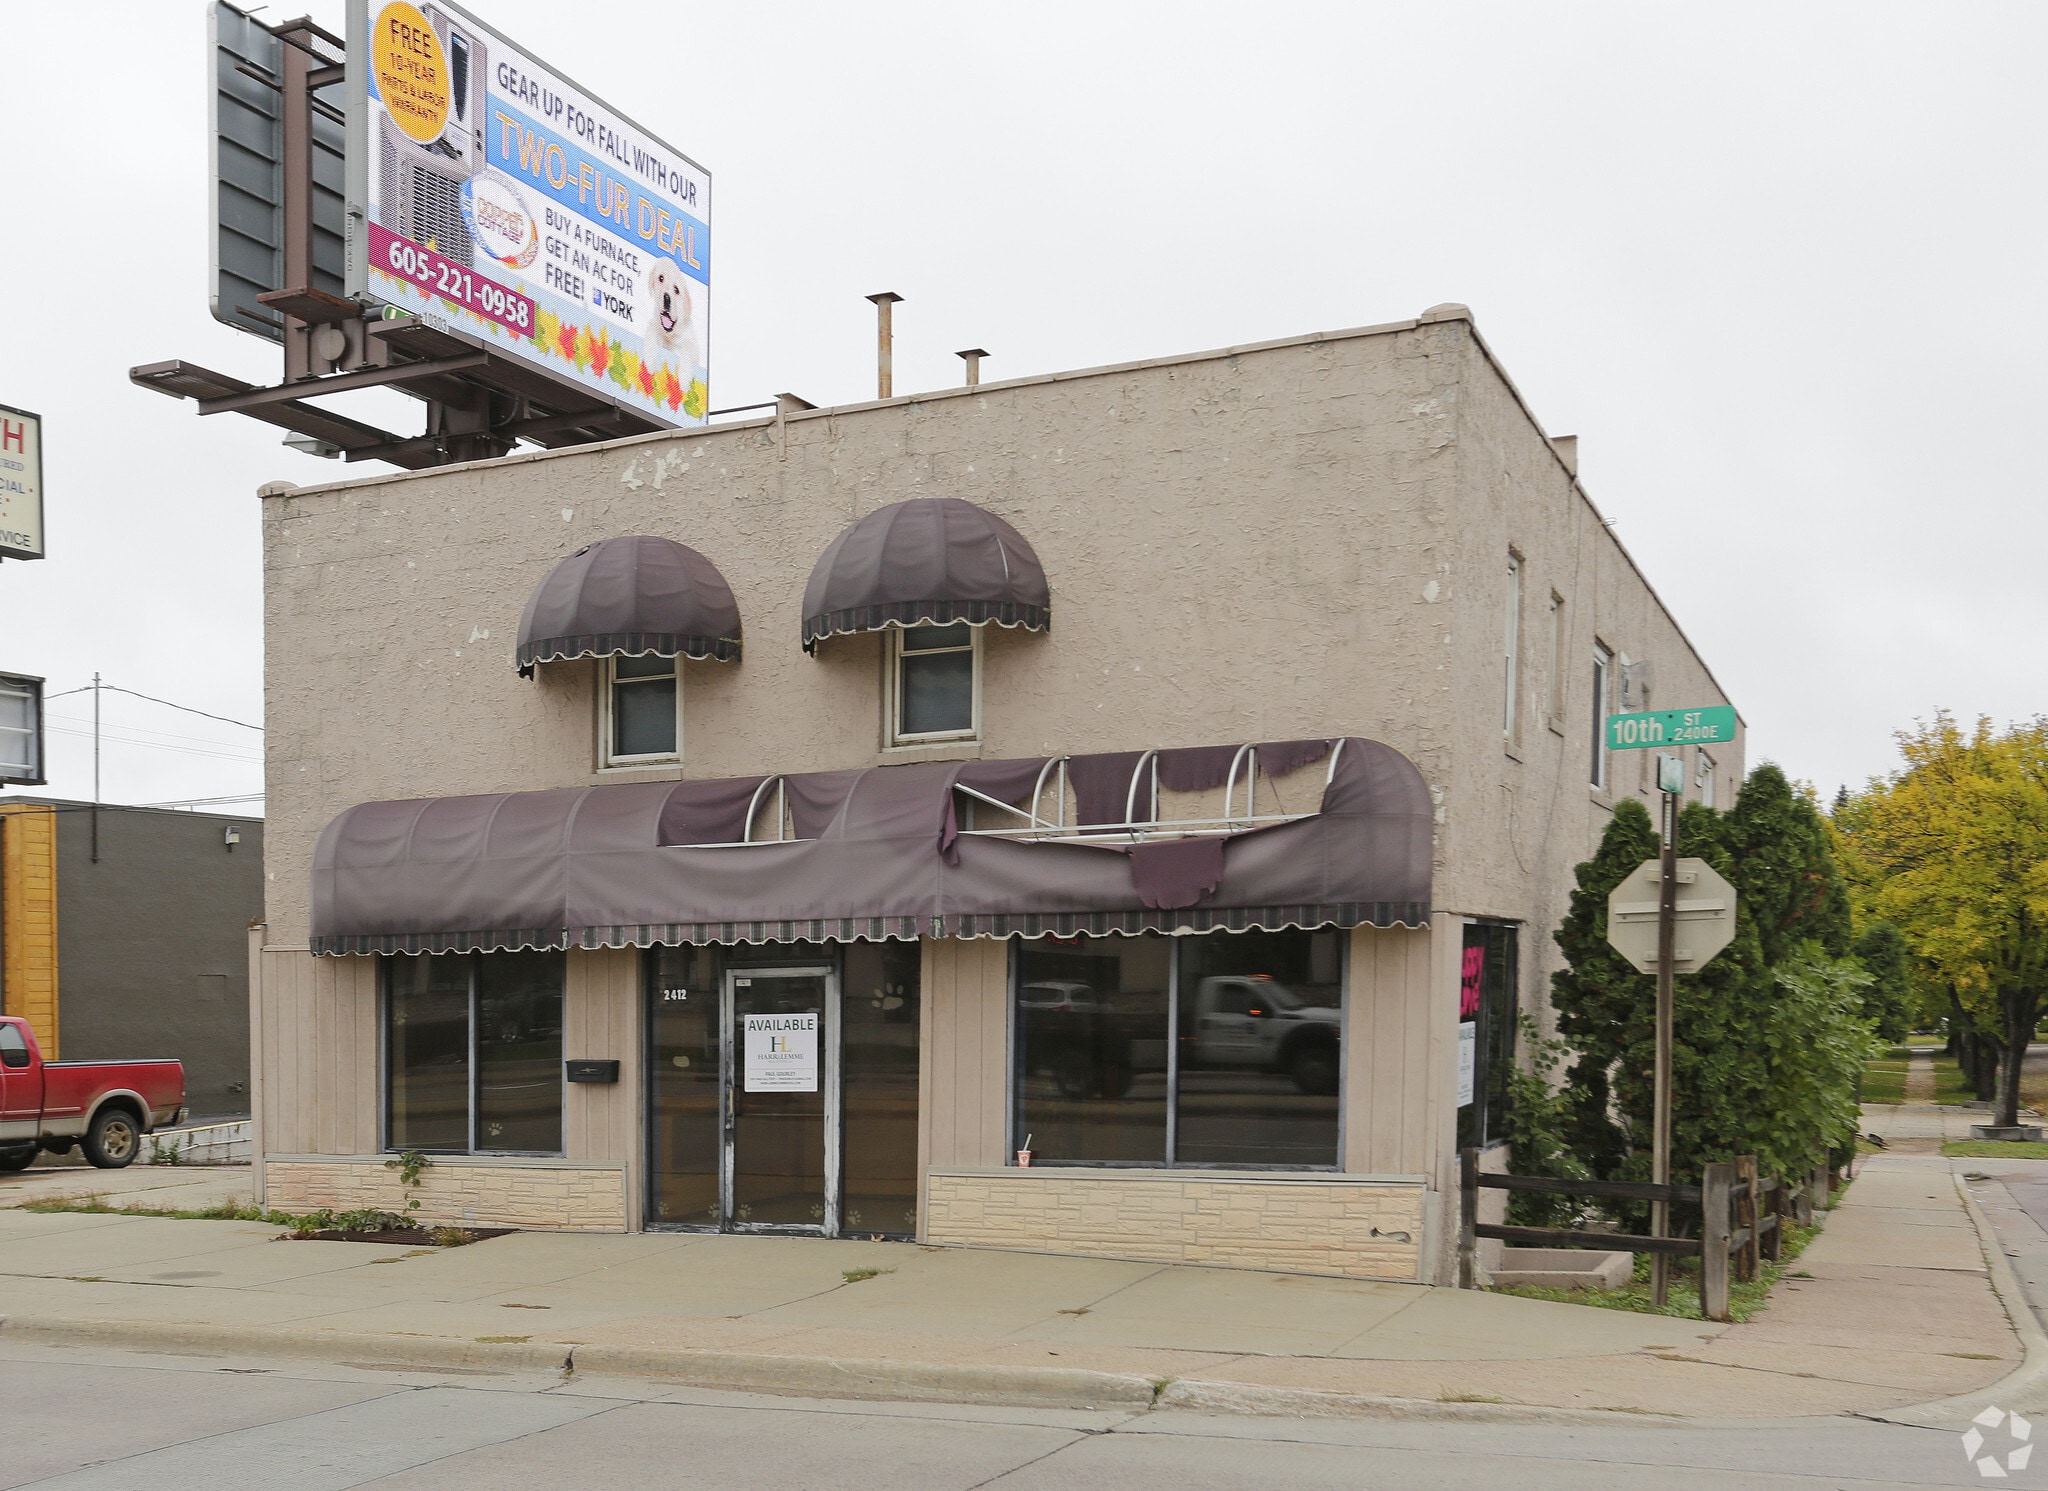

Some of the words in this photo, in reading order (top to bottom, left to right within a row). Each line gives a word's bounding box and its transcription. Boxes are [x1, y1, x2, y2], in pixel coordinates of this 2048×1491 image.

[389, 18, 434, 59] FREE
[389, 52, 437, 85] 10-YEAR
[497, 62, 539, 110] GEAR
[543, 88, 563, 121] UP
[567, 103, 595, 144] FOR
[599, 123, 631, 165] FALL
[633, 145, 667, 188] WITH
[670, 171, 697, 208] OUR
[495, 110, 631, 230] TWO-FUR
[637, 195, 701, 270] DEAL
[545, 207, 571, 236] BUY
[574, 224, 582, 242] A
[585, 228, 641, 277] FURNACE,
[388, 240, 529, 328] 605-221-0958
[545, 235, 570, 262] GET
[572, 250, 590, 273] AN
[592, 259, 608, 283] AC
[611, 268, 633, 296] FOR
[545, 262, 585, 301] FREE!
[602, 291, 634, 322] YORK
[0, 417, 24, 454] H
[0, 529, 31, 547] VICE
[1613, 717, 1663, 744] 10th
[1684, 712, 1702, 726] ST
[1673, 725, 1719, 741] 2400E
[664, 989, 687, 1000] 2412
[748, 1018, 814, 1031] AVAILABLE
